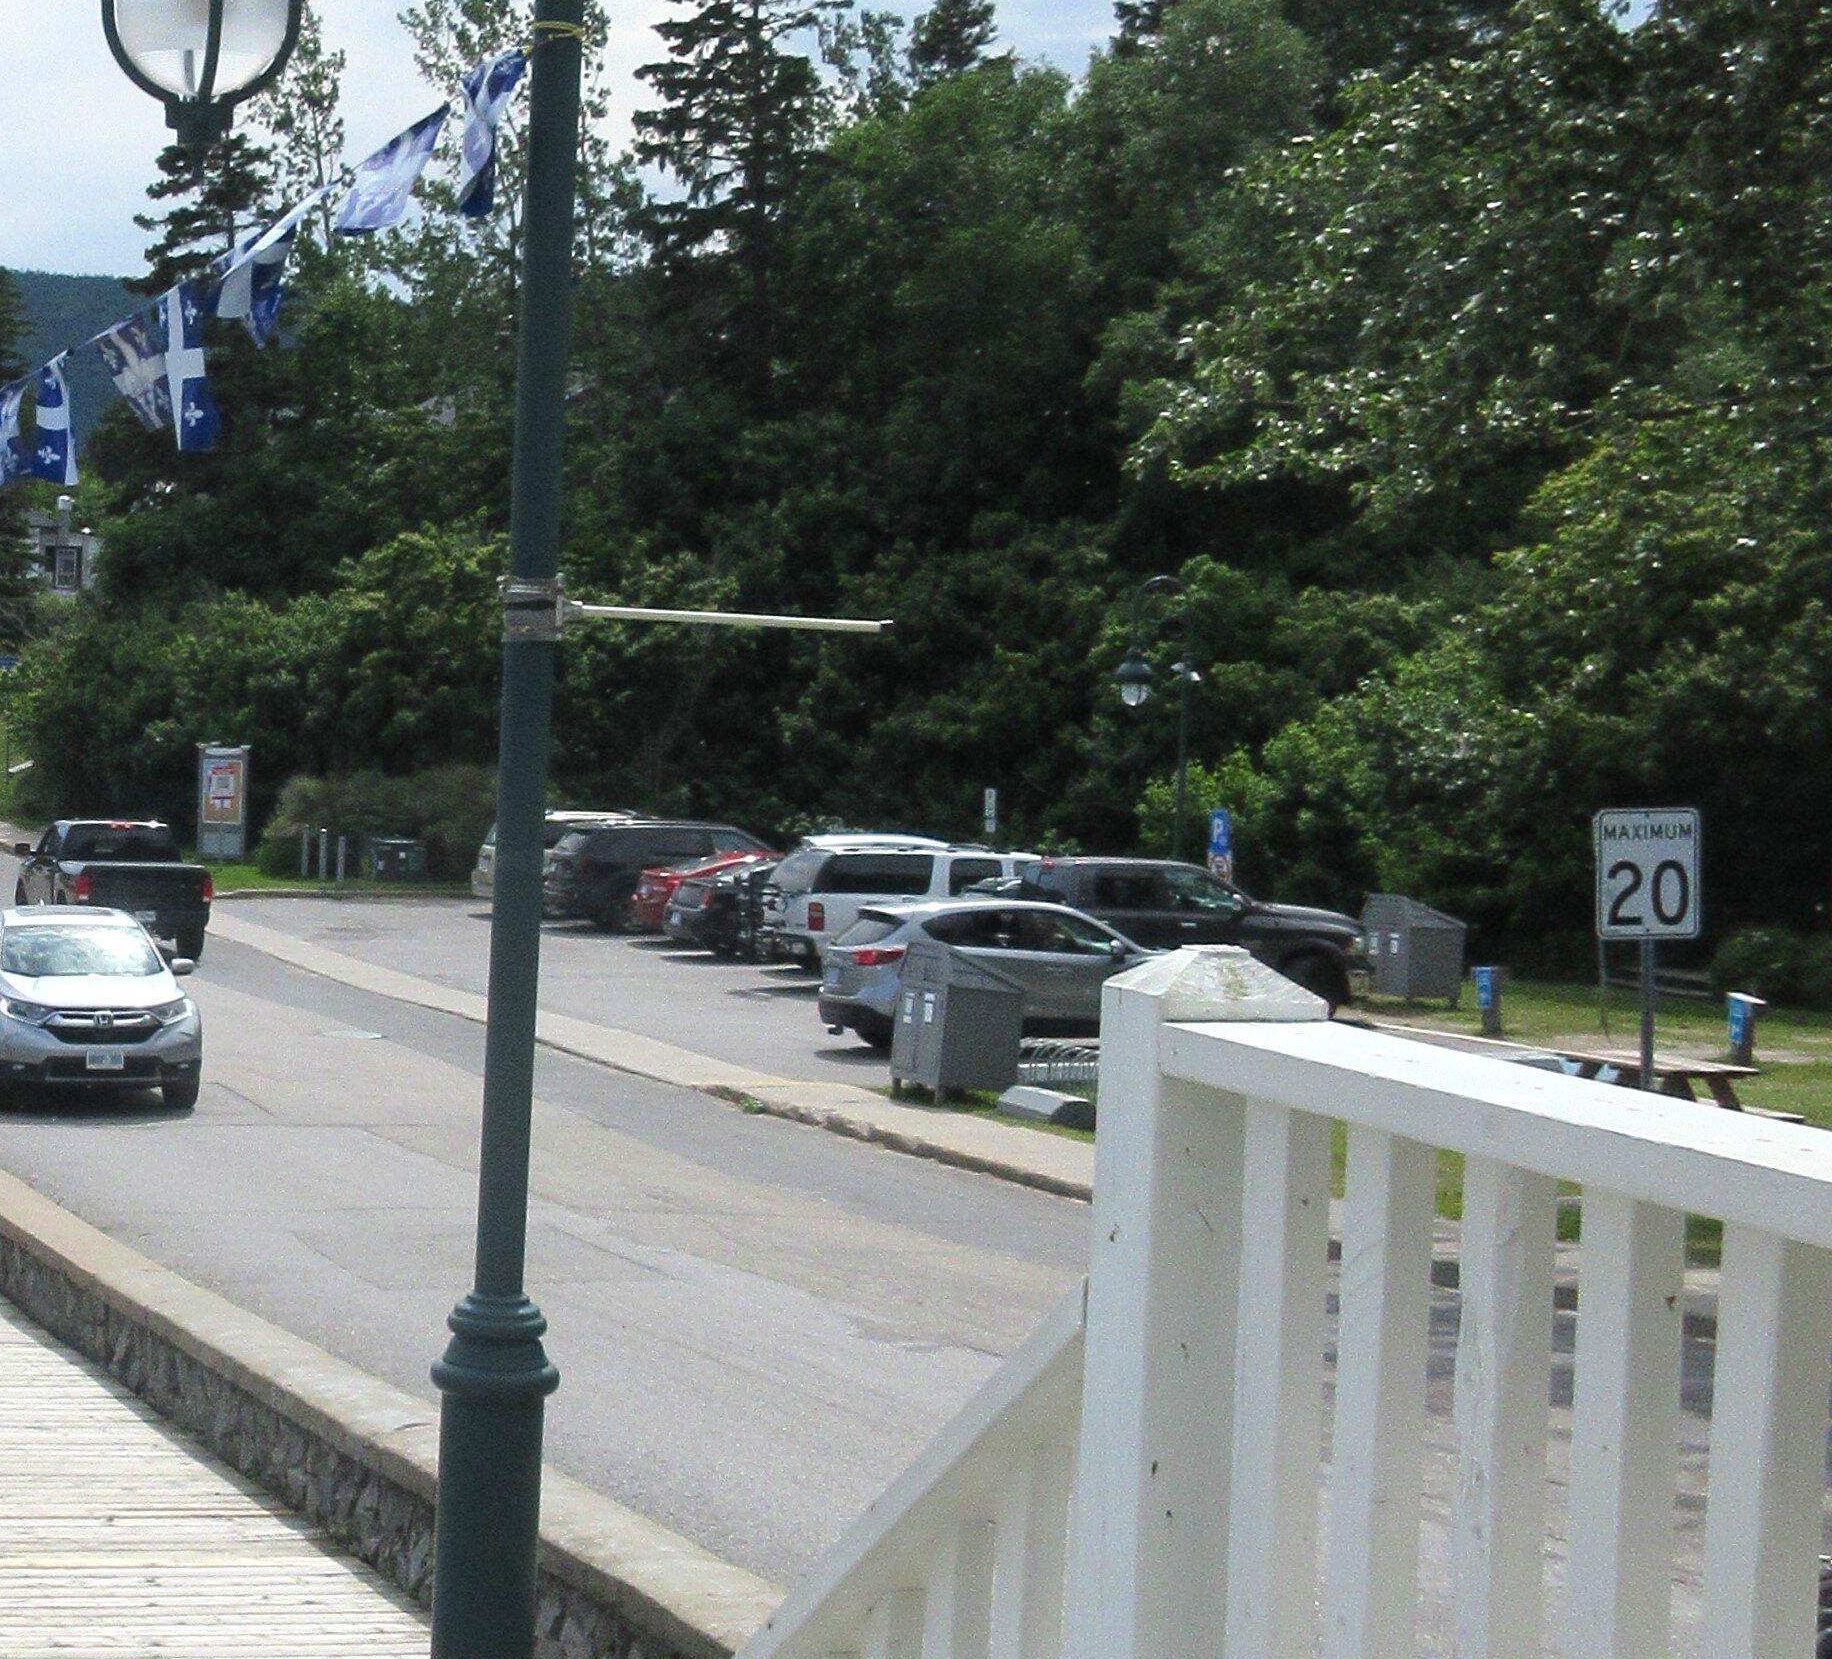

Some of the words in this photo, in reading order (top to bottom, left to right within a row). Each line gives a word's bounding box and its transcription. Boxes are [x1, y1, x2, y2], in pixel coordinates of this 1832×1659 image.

[1212, 816, 1224, 843] P
[1604, 823, 1693, 840] MAXIMUM
[1606, 859, 1689, 927] 20
